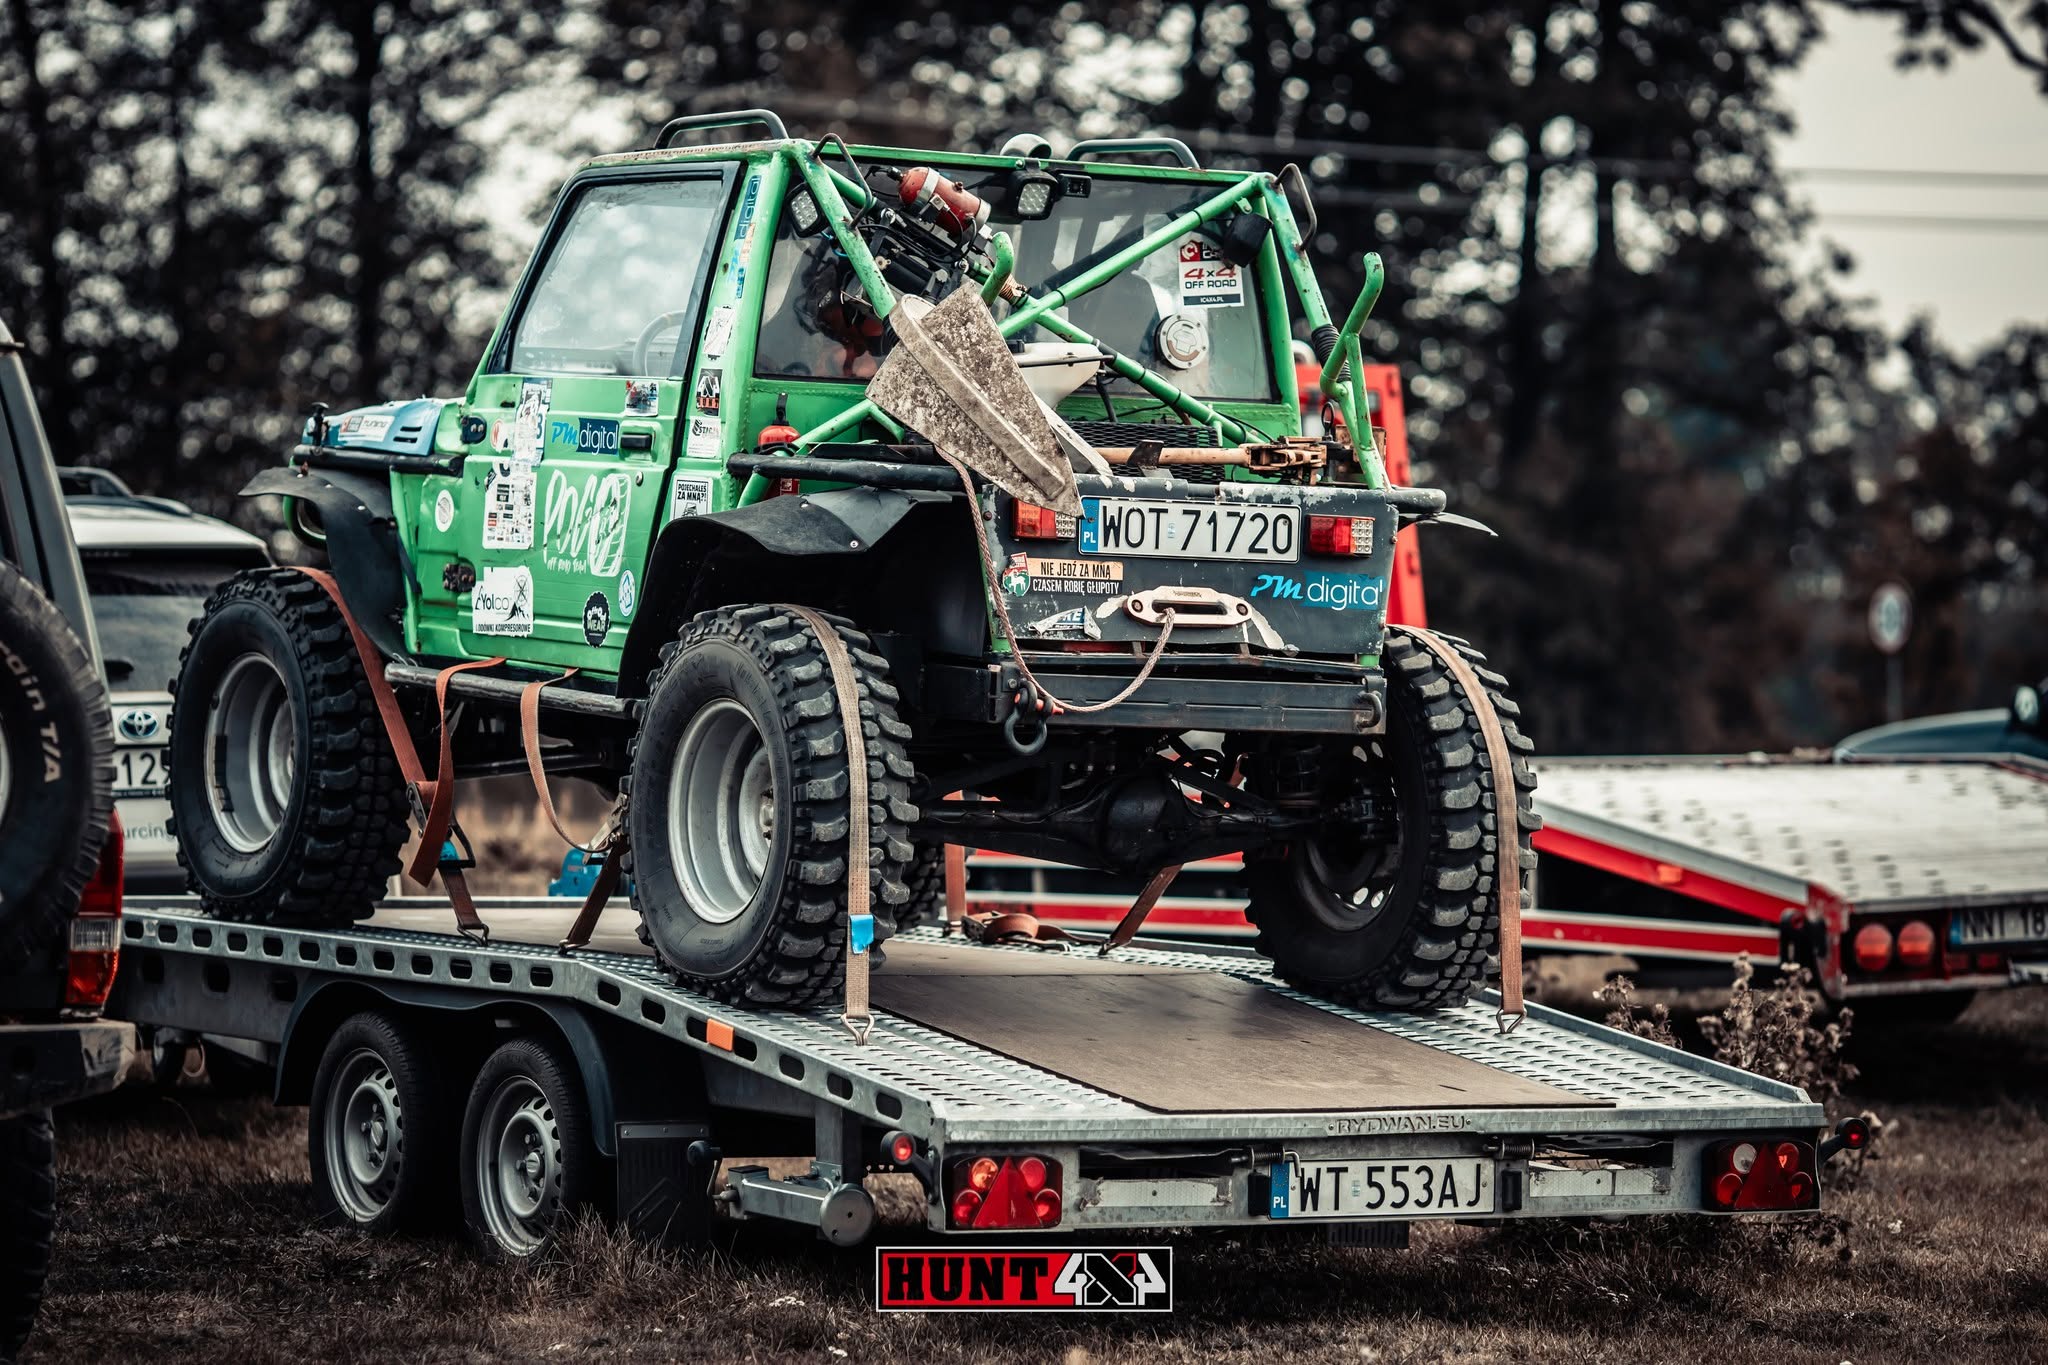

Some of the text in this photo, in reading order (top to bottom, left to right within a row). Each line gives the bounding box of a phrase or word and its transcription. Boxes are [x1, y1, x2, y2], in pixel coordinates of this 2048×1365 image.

[1185, 279, 1237, 289] OFF ROAD
[579, 423, 619, 455] digital
[677, 491, 686, 501] ZA
[1083, 506, 1292, 554] PL WOT 71720
[1041, 561, 1111, 579] NIE JEDŹ ZA MNĄ
[1032, 579, 1119, 596] CZASEM ROBIĘ GŁUPOTY
[1337, 1115, 1465, 1134] RYDWAN.EU
[1273, 1164, 1481, 1211] PL WT 553AJ
